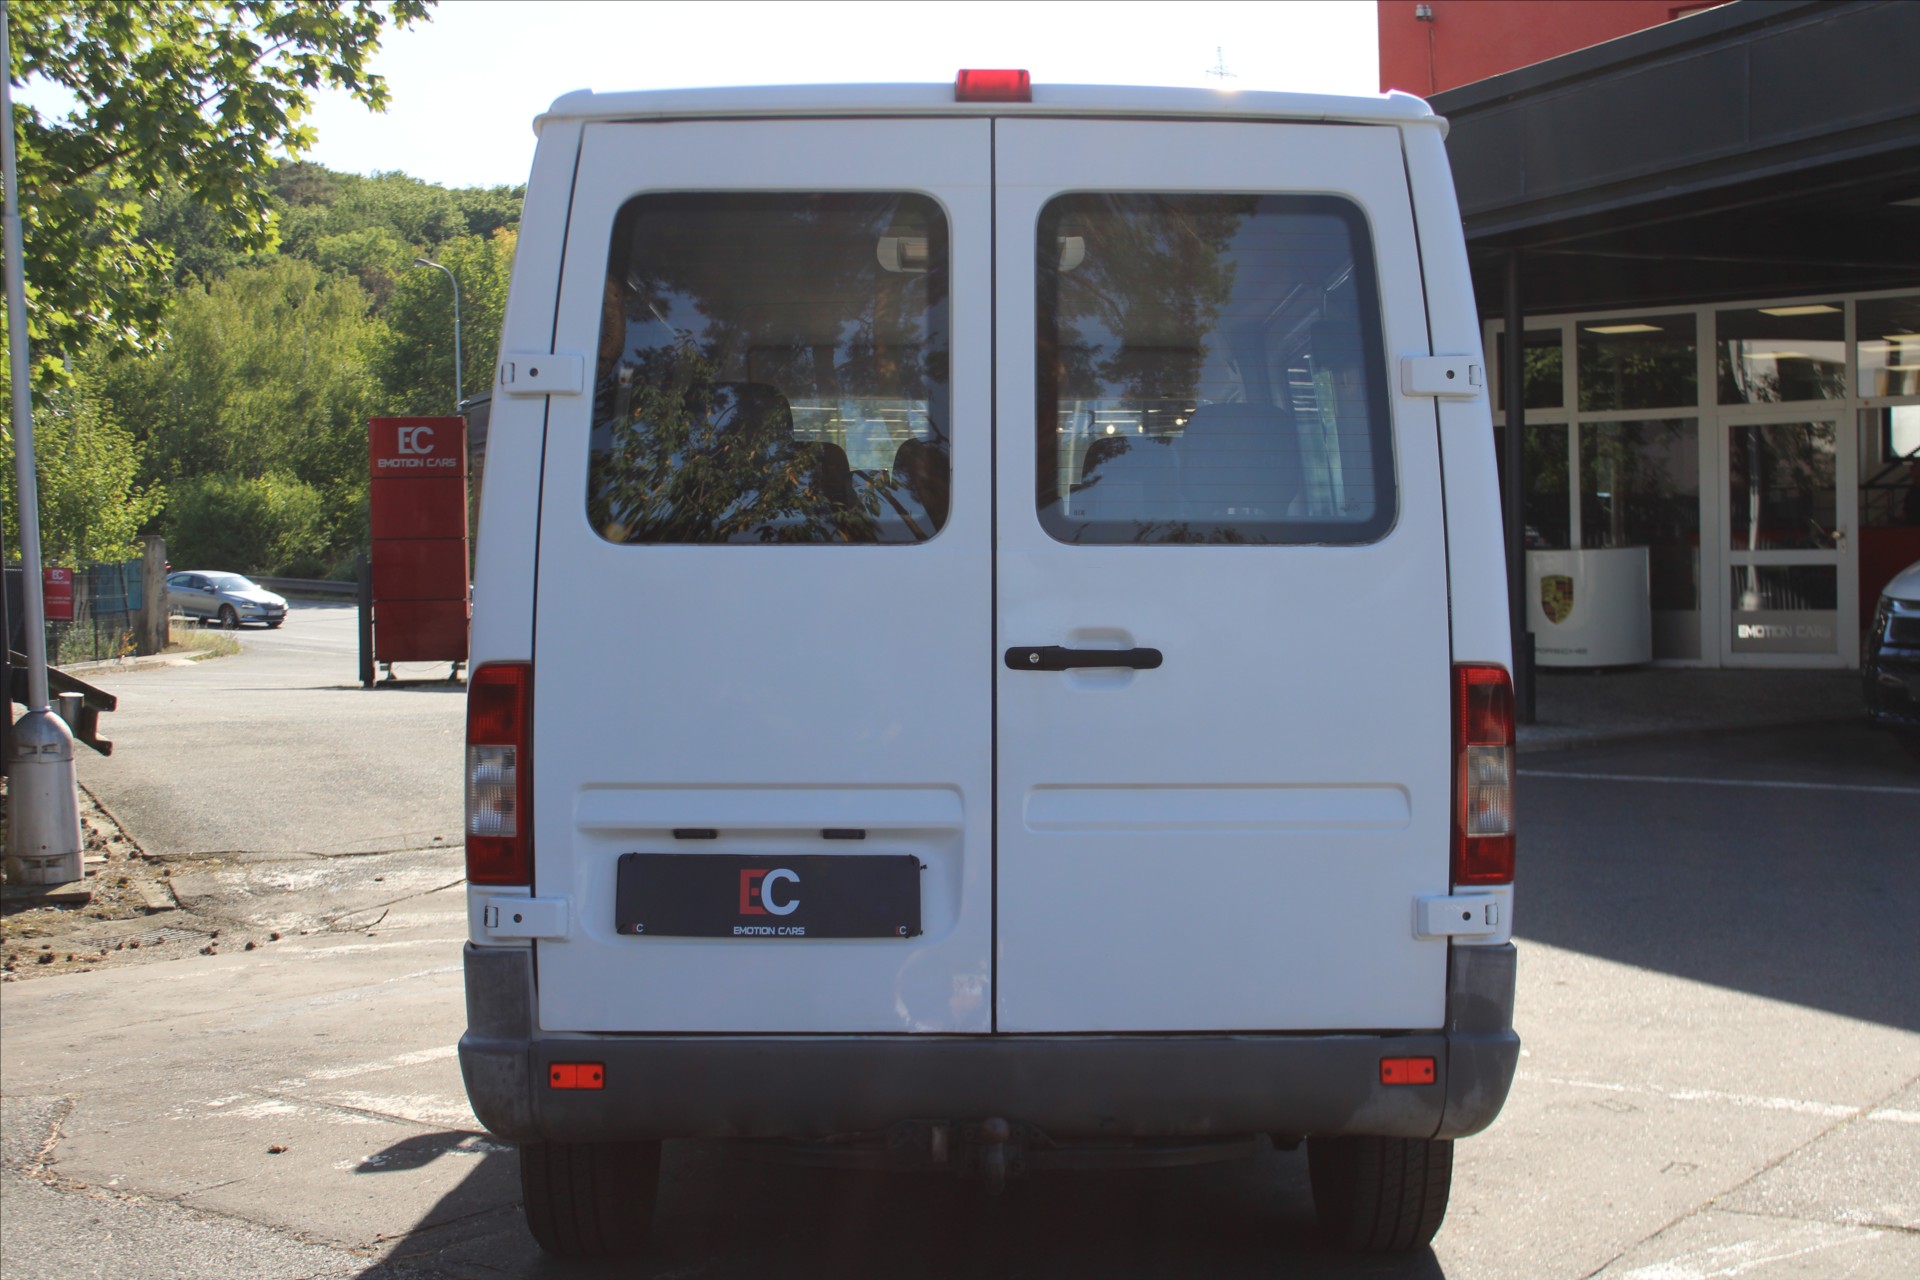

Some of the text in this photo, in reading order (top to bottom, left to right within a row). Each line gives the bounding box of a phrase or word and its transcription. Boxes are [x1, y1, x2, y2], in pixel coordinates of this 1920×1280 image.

[398, 426, 434, 454] EC
[378, 458, 456, 468] EMOTION CARS
[1738, 624, 1793, 638] EMOTION
[739, 868, 800, 915] EC
[733, 926, 805, 935] EMOTION CARS
